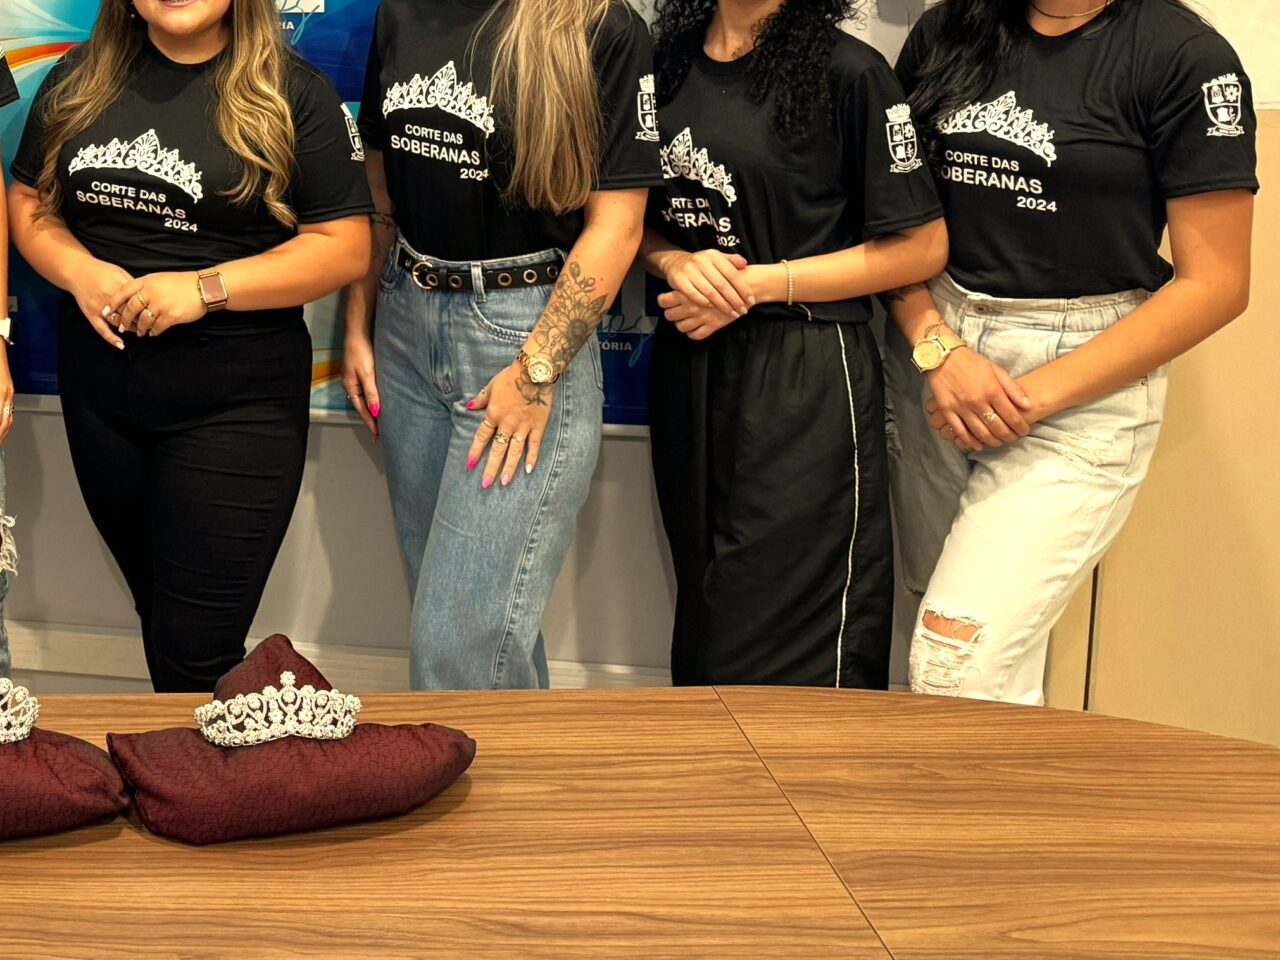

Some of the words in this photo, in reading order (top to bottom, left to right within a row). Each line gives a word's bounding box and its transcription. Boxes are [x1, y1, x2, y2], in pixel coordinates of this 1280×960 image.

[405, 123, 441, 141] CORTE
[443, 131, 463, 145] DAS
[391, 135, 480, 165] SOBERANAS
[945, 150, 989, 166] CORTE
[992, 157, 1019, 171] DAS
[460, 168, 489, 181] 2024
[940, 165, 1042, 194] OBERANAS
[91, 181, 136, 197] CORTE
[139, 189, 166, 203] DAS
[76, 190, 186, 219] SOBERANAS
[1017, 196, 1057, 212] 2024
[164, 218, 198, 233] 2024
